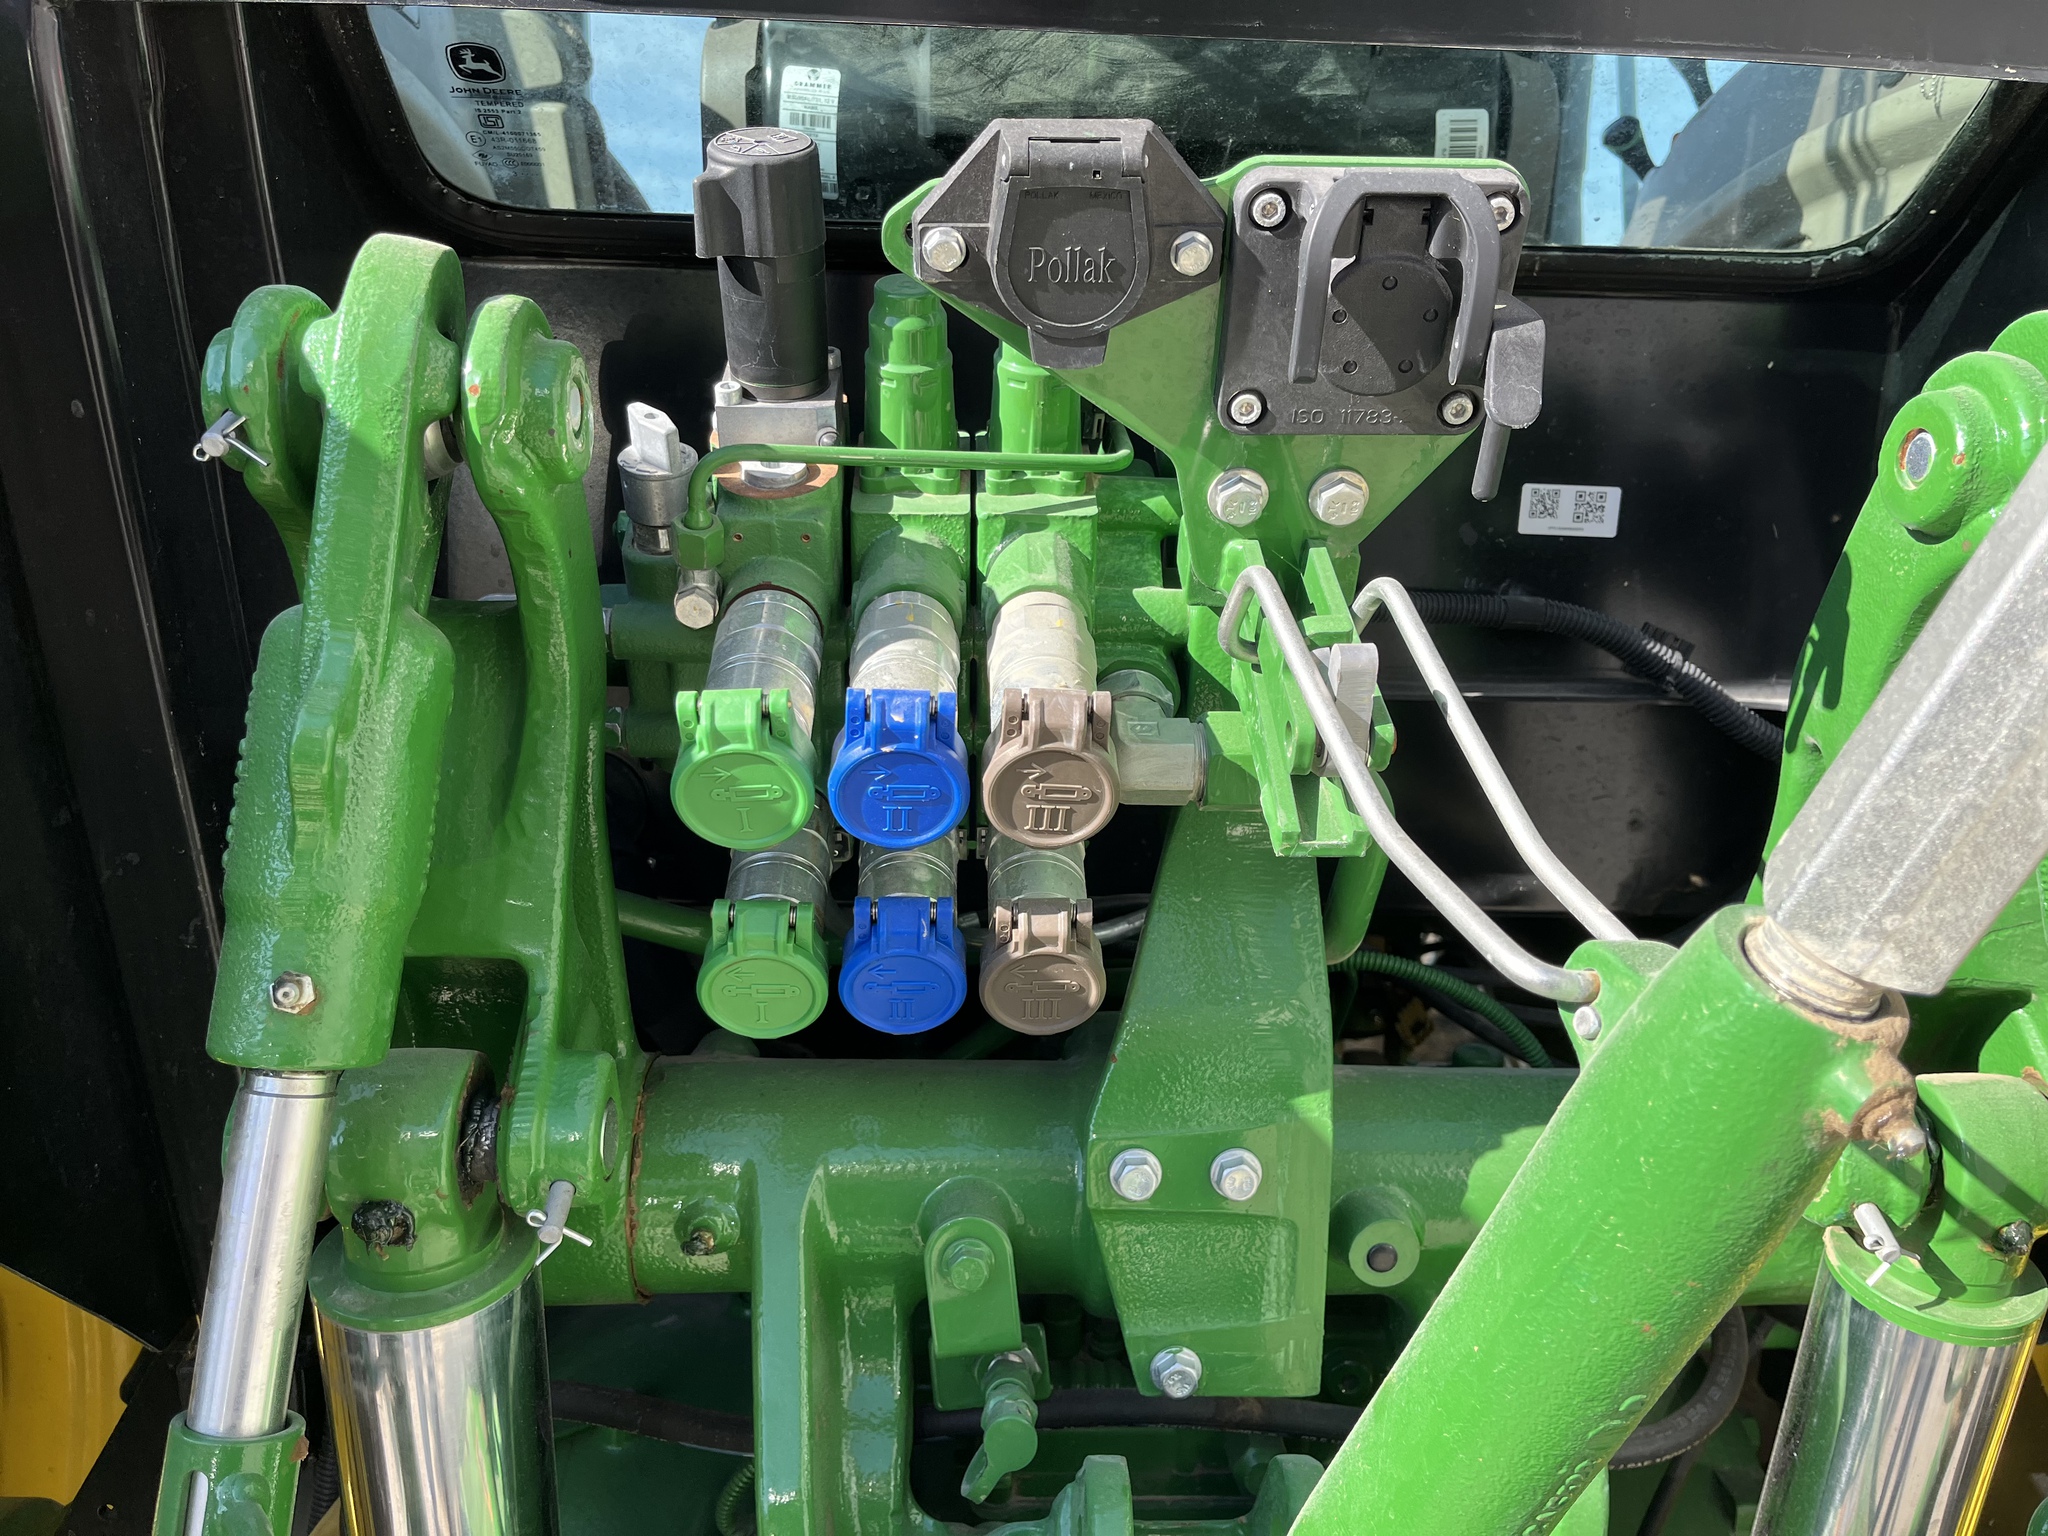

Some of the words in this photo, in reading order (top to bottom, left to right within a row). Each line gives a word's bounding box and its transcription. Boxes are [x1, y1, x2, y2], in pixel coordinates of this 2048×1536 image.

[449, 86, 480, 94] JOHN
[482, 87, 523, 96] DEERE
[794, 81, 832, 89] GRAMMER
[475, 100, 525, 108] TEMPERED
[1024, 190, 1060, 200] POLLAK
[1089, 191, 1123, 200] MEXICO
[1028, 246, 1116, 283] Pollak
[1291, 408, 1325, 424] ISO
[736, 806, 754, 833] I
[881, 805, 913, 833] II
[1023, 803, 1072, 833] III
[755, 1000, 769, 1024] I
[889, 999, 915, 1020] II
[1021, 998, 1063, 1020] III
